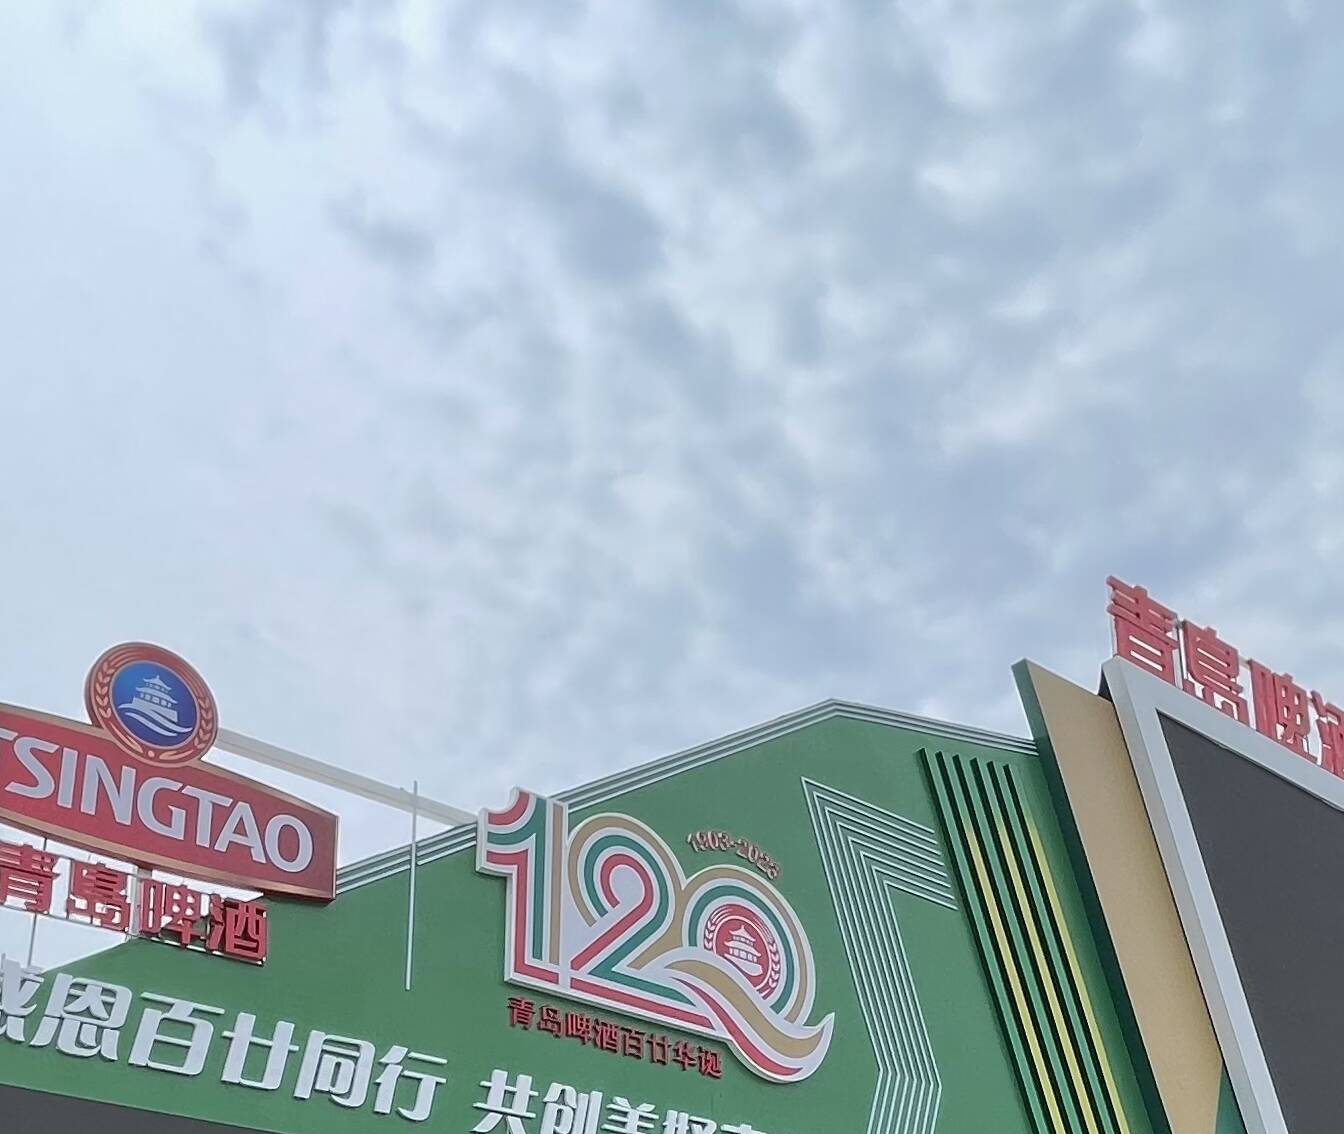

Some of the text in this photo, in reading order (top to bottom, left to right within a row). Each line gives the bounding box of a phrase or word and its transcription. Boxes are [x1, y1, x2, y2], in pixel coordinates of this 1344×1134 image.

[687, 831, 781, 880] 1903-2023
[475, 786, 836, 1085] 120
[506, 996, 723, 1078] 青岛啤酒百廿华诞
